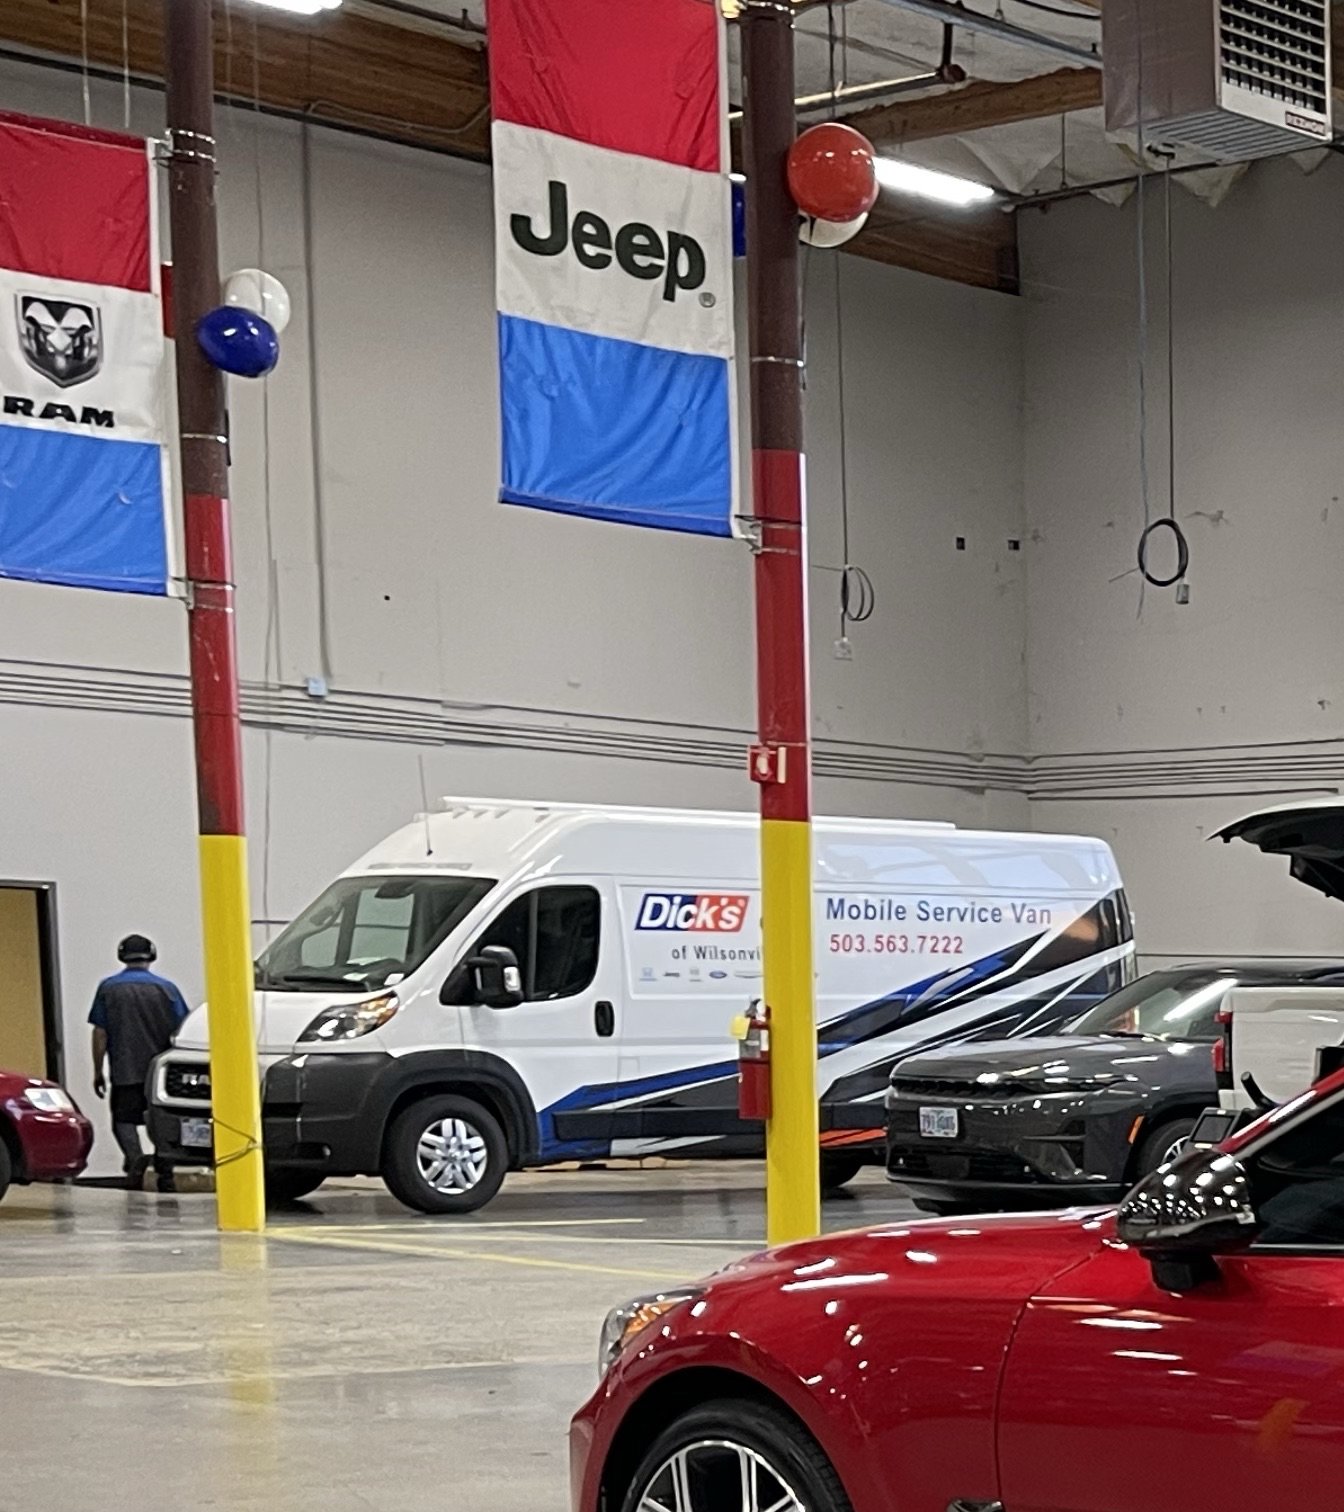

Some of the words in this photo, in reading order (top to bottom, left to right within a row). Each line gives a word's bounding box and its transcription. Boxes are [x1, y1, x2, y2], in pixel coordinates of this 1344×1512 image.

[510, 179, 706, 303] Jeep
[3, 395, 115, 428] RAM
[640, 896, 743, 930] Dick's
[827, 898, 907, 922] Mobile
[917, 900, 1001, 924] Service
[1011, 902, 1051, 924] Van
[671, 946, 687, 960] of
[693, 945, 761, 960] Wilsonvi
[829, 934, 964, 954] 503.563.7222
